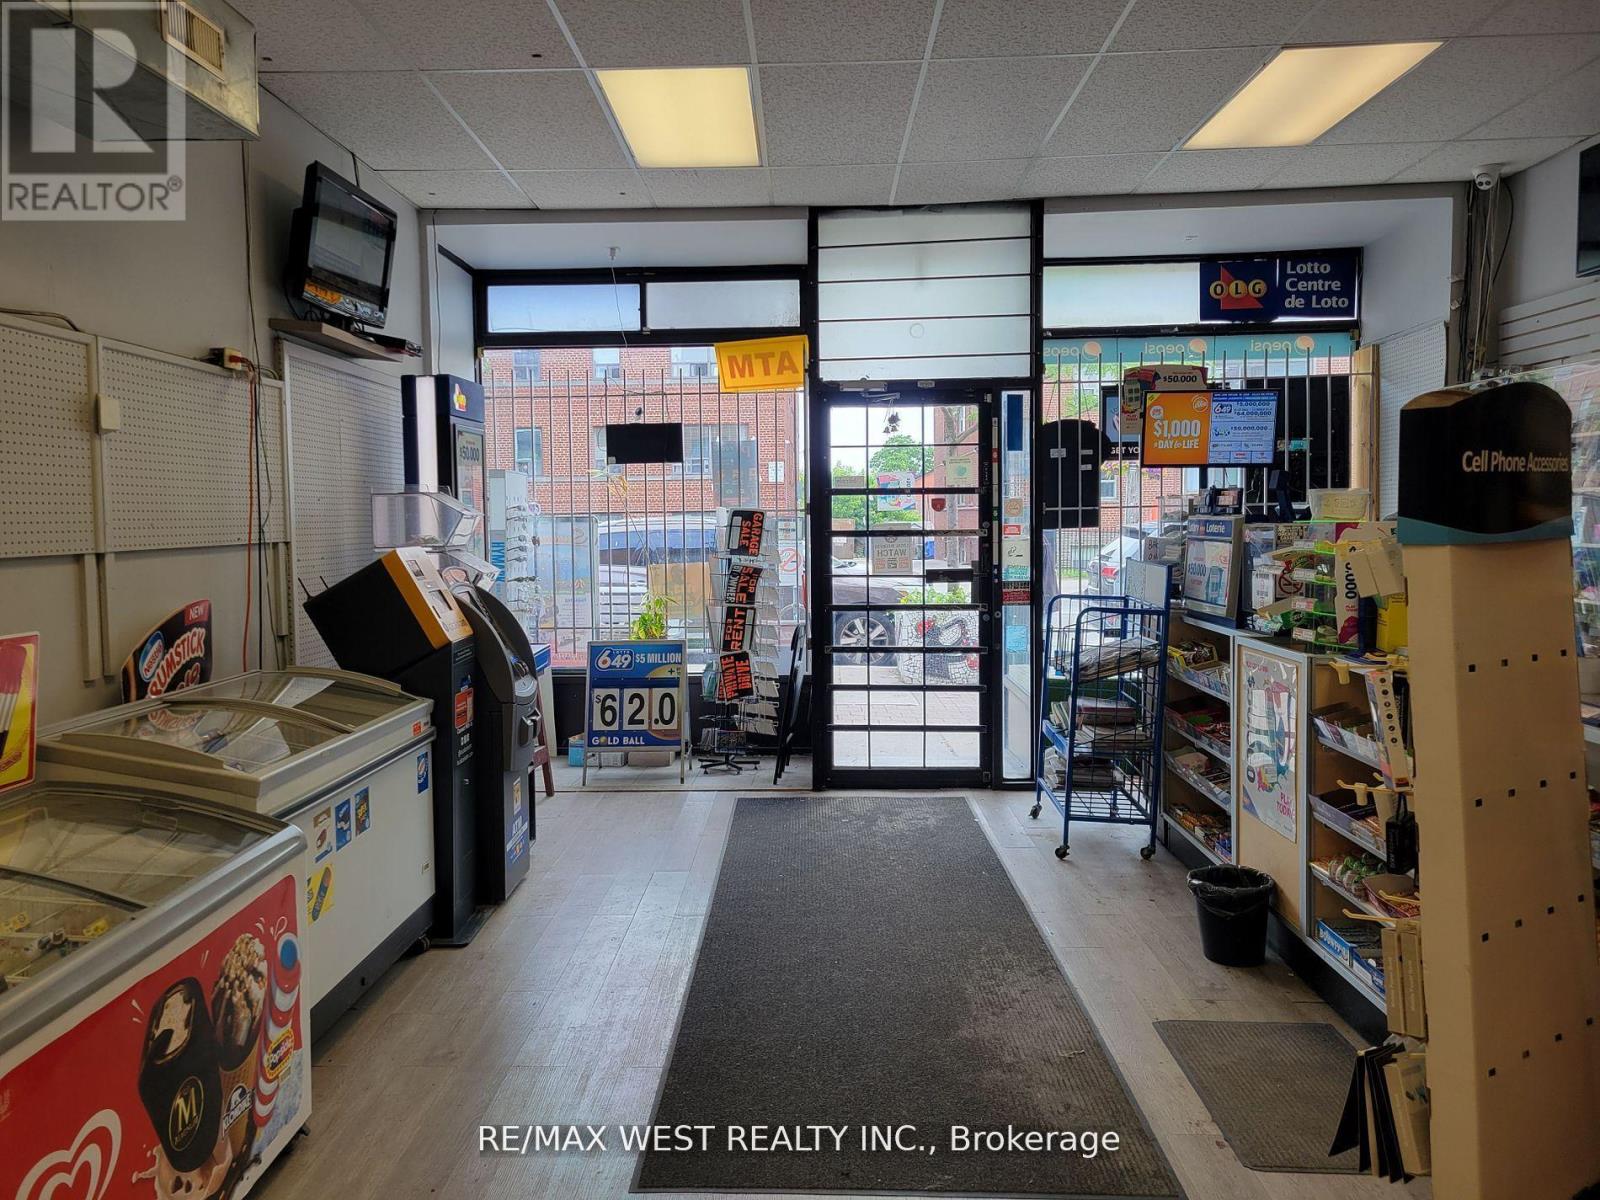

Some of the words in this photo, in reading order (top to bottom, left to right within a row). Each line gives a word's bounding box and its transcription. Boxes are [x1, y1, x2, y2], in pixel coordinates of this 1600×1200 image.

[1286, 260, 1331, 275] Lotto
[1211, 280, 1266, 297] OLG
[1285, 277, 1342, 292] Centre
[1285, 295, 1305, 309] de
[1312, 294, 1349, 309] Loto
[1154, 420, 1201, 438] $1,000
[1158, 441, 1174, 449] DAY
[1183, 440, 1199, 449] LIFE
[1462, 450, 1488, 472] Cell
[1491, 450, 1526, 473] Phone
[1528, 451, 1570, 473] Accessories
[740, 520, 752, 547] SALE
[748, 513, 764, 556] GARAGE
[1206, 522, 1226, 533] Loterie
[735, 566, 754, 604] SALE
[189, 605, 205, 621] NEW
[730, 608, 746, 650] RENT
[147, 627, 206, 698] RUMSTICK
[635, 653, 646, 664] $5
[647, 652, 682, 664] MILLION
[623, 736, 645, 745] BALL
